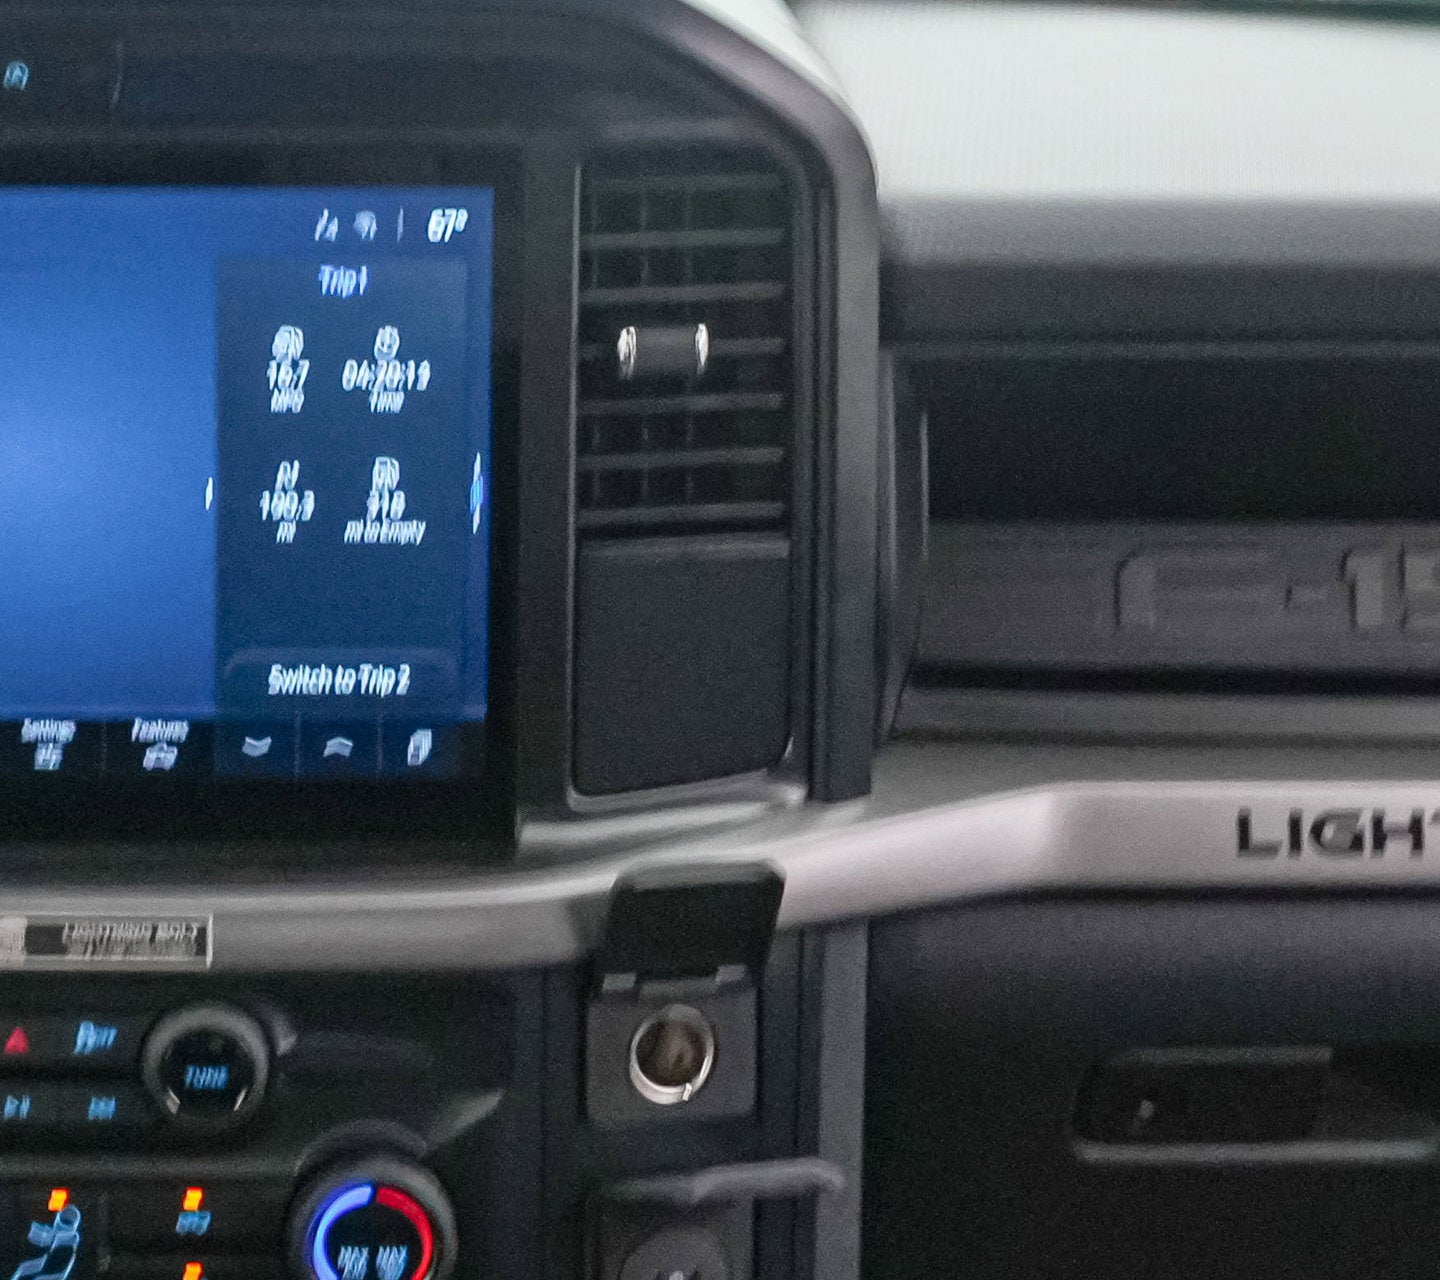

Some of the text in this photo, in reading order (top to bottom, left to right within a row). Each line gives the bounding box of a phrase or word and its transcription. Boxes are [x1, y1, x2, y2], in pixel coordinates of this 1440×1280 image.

[268, 663, 333, 696] Switch
[334, 664, 356, 695] to
[358, 663, 396, 698] Trip
[21, 718, 77, 744] Settings
[131, 717, 190, 743] Features
